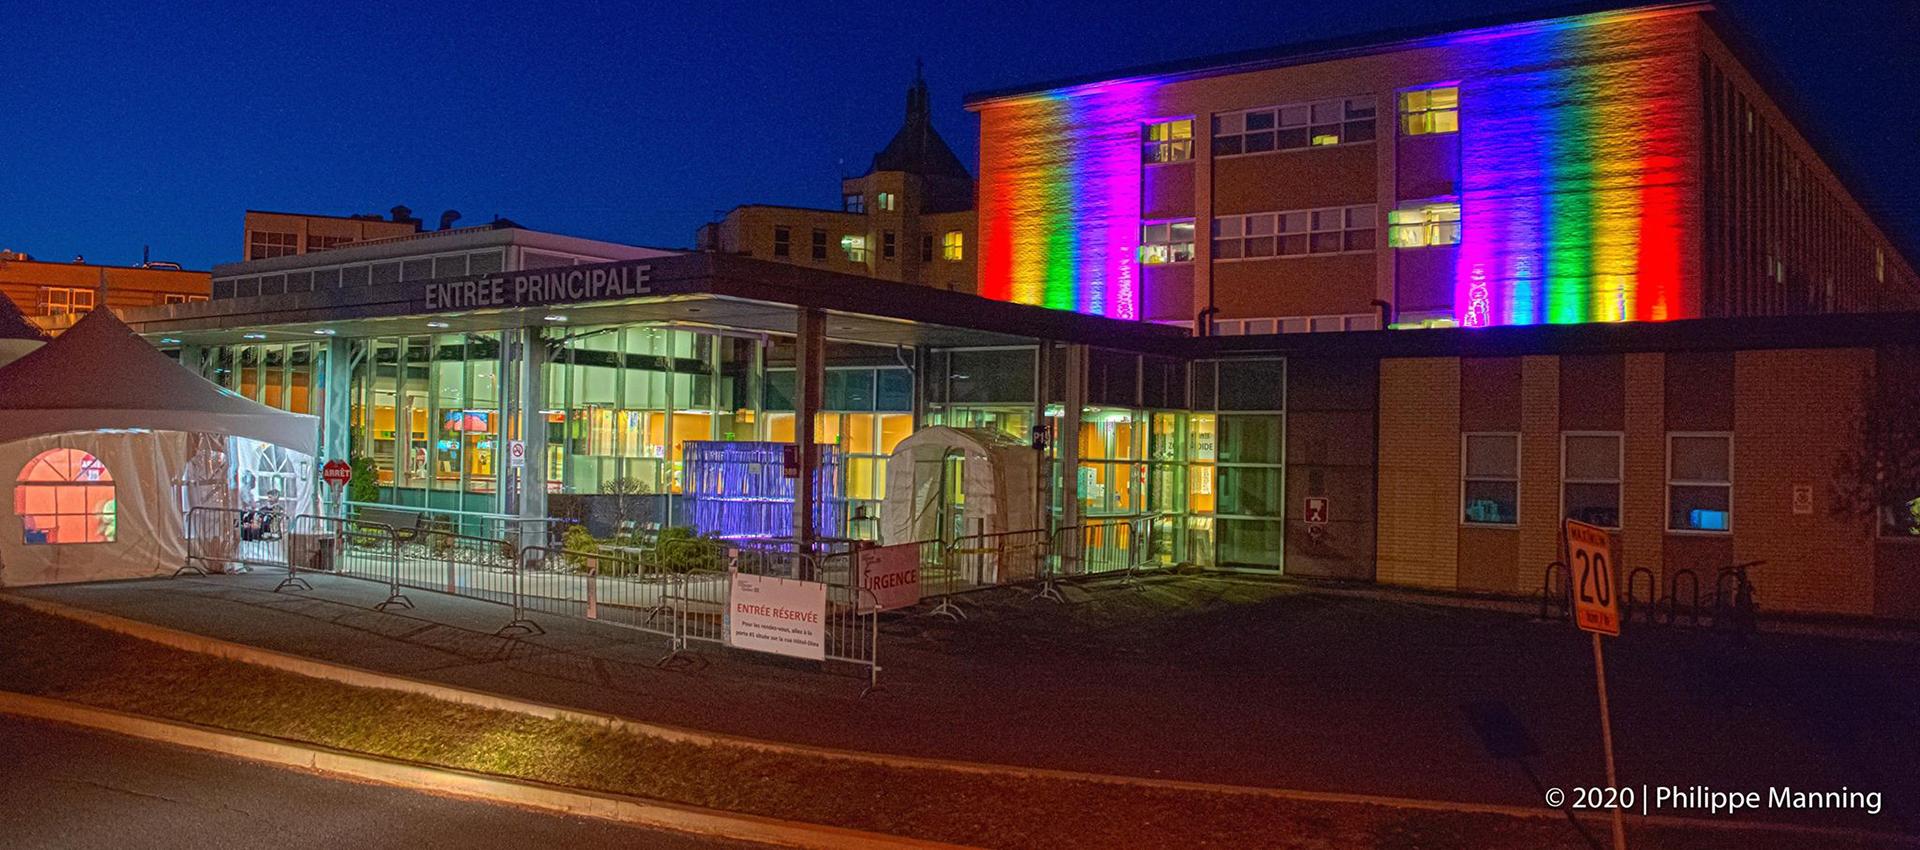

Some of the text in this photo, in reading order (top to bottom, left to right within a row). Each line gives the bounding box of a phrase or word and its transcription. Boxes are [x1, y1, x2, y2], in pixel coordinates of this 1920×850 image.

[425, 264, 651, 309] ENTRÉE PRINCIPALE
[324, 468, 350, 477] ARRÊT
[864, 569, 917, 591] URGENCE
[1576, 549, 1609, 606] 20
[737, 603, 818, 623] ENTRÉE RÉSERVÉE
[735, 630, 748, 638] porte
